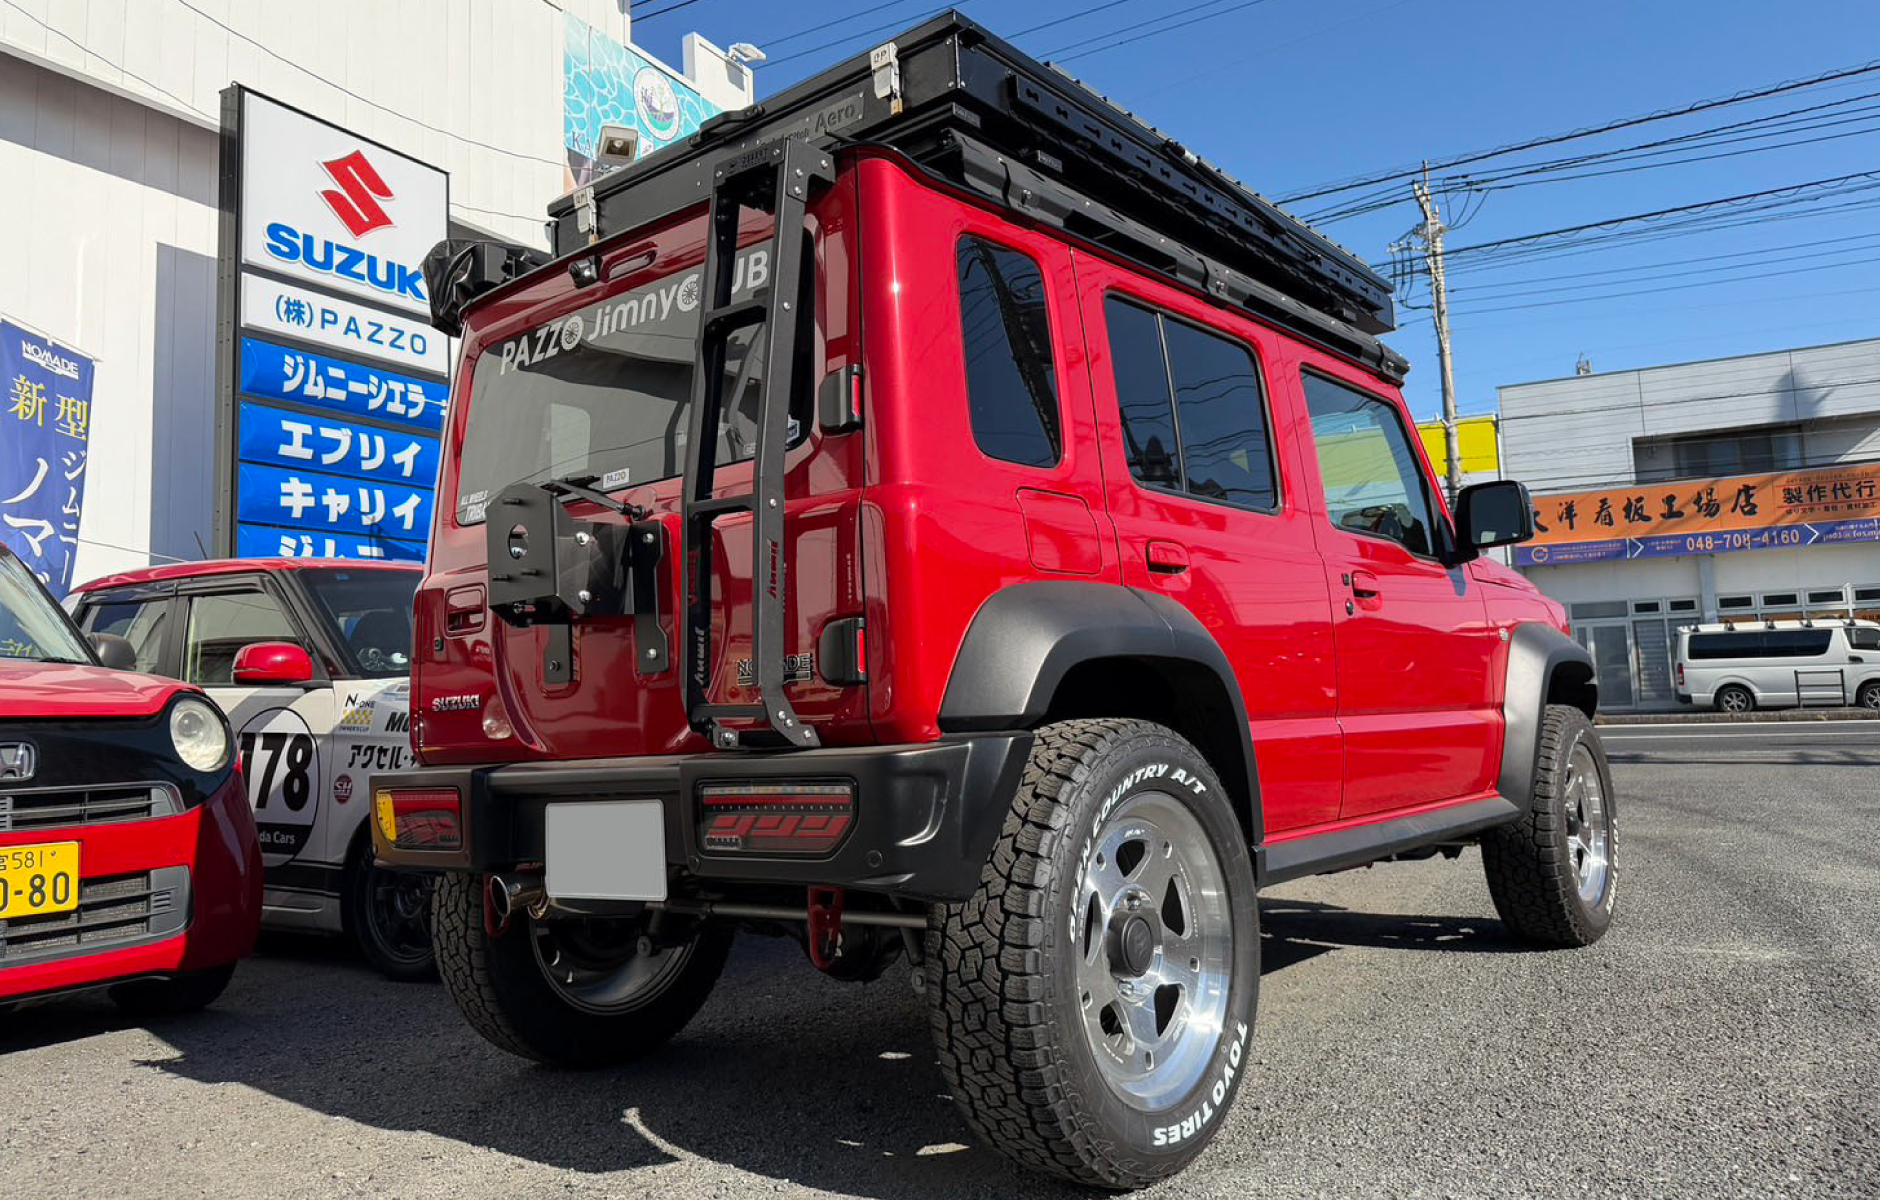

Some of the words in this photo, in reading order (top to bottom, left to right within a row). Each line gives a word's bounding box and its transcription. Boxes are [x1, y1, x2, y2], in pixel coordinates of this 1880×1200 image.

[815, 104, 855, 132] Aero
[266, 222, 427, 301] SUZUK
[22, 340, 79, 374] NOMADE
[501, 315, 584, 375] PAZZO
[8, 374, 88, 441] 新型
[283, 354, 426, 419] ジムニーシエラ
[0, 458, 55, 585] ノマ
[59, 450, 87, 584] ジムニー
[1783, 480, 1876, 504] 製作代行
[1687, 529, 1799, 551] 048-708-4160
[431, 694, 480, 711] SUZUKI
[1093, 763, 1169, 838] COUNTRY
[1170, 767, 1207, 795] A/T
[273, 831, 295, 844] Cars
[1212, 1021, 1248, 1106] TOYO
[1154, 1101, 1213, 1146] TIRES
